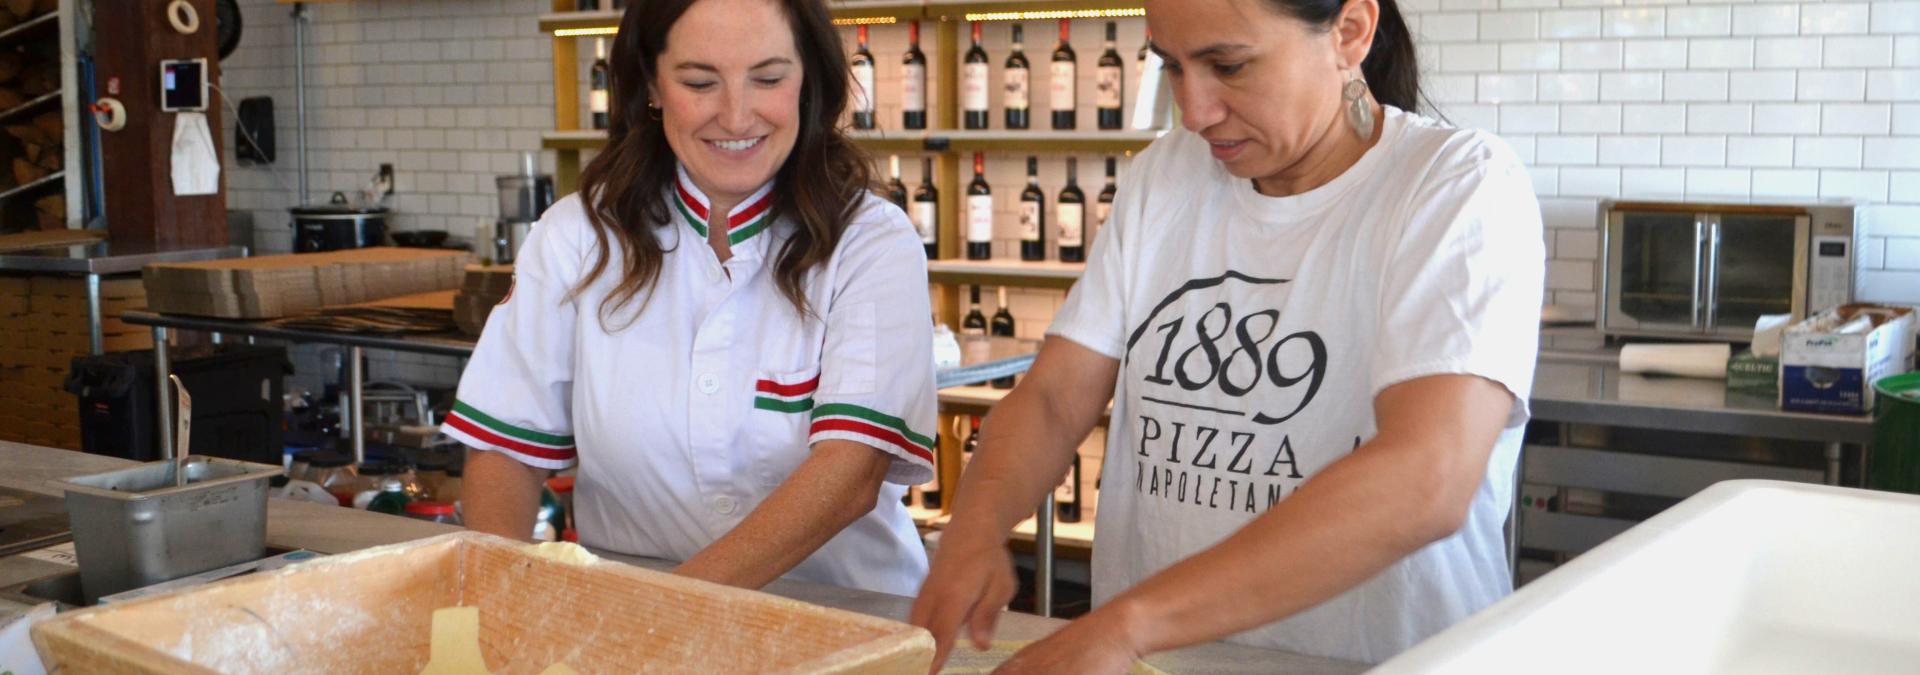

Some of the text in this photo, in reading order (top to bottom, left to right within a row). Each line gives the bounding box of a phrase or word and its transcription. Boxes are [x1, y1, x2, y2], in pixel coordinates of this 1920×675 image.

[1144, 302, 1328, 424] 1889
[1138, 415, 1304, 479] PIZZA
[1136, 460, 1299, 514] NAPOLETAN
